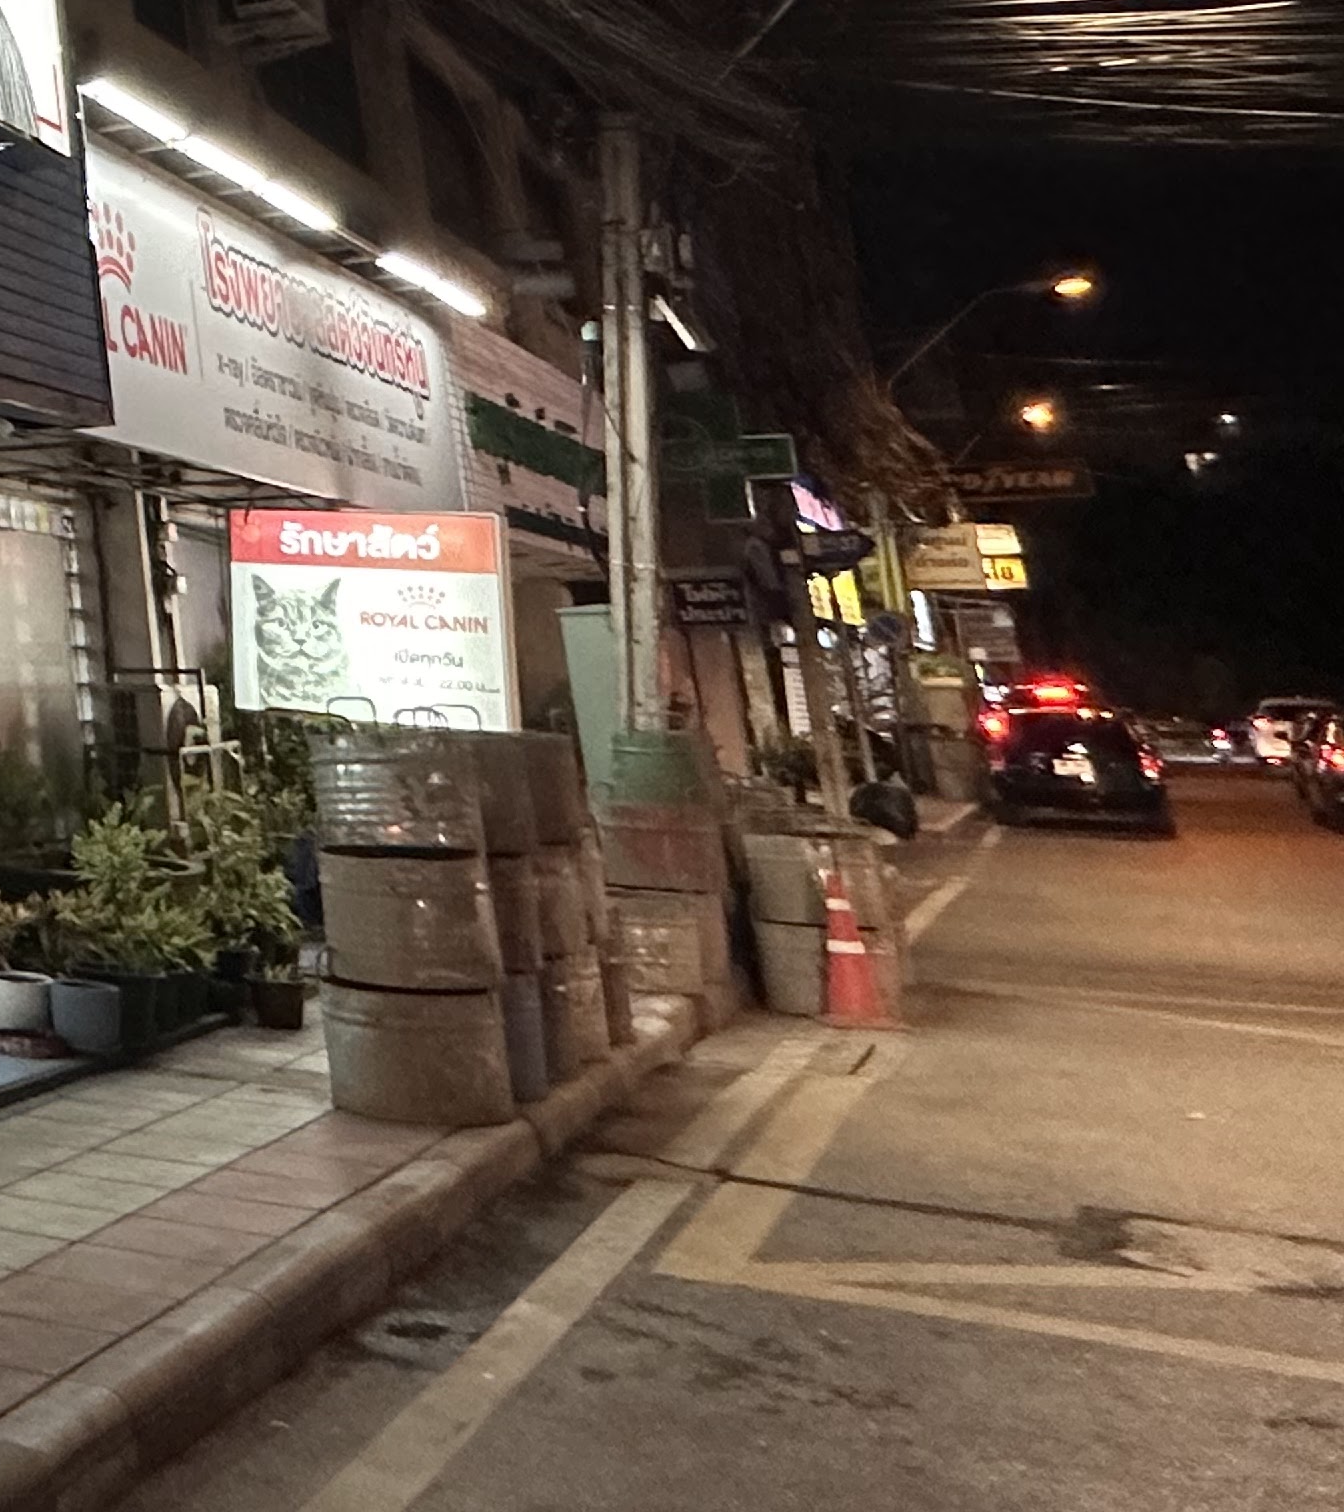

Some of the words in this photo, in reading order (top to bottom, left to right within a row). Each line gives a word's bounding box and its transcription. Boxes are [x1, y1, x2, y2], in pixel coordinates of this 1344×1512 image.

[121, 303, 188, 376] CANIN
[279, 520, 441, 561] รักษาสัตว์
[360, 611, 419, 630] ROYAL
[424, 614, 489, 635] CANIN
